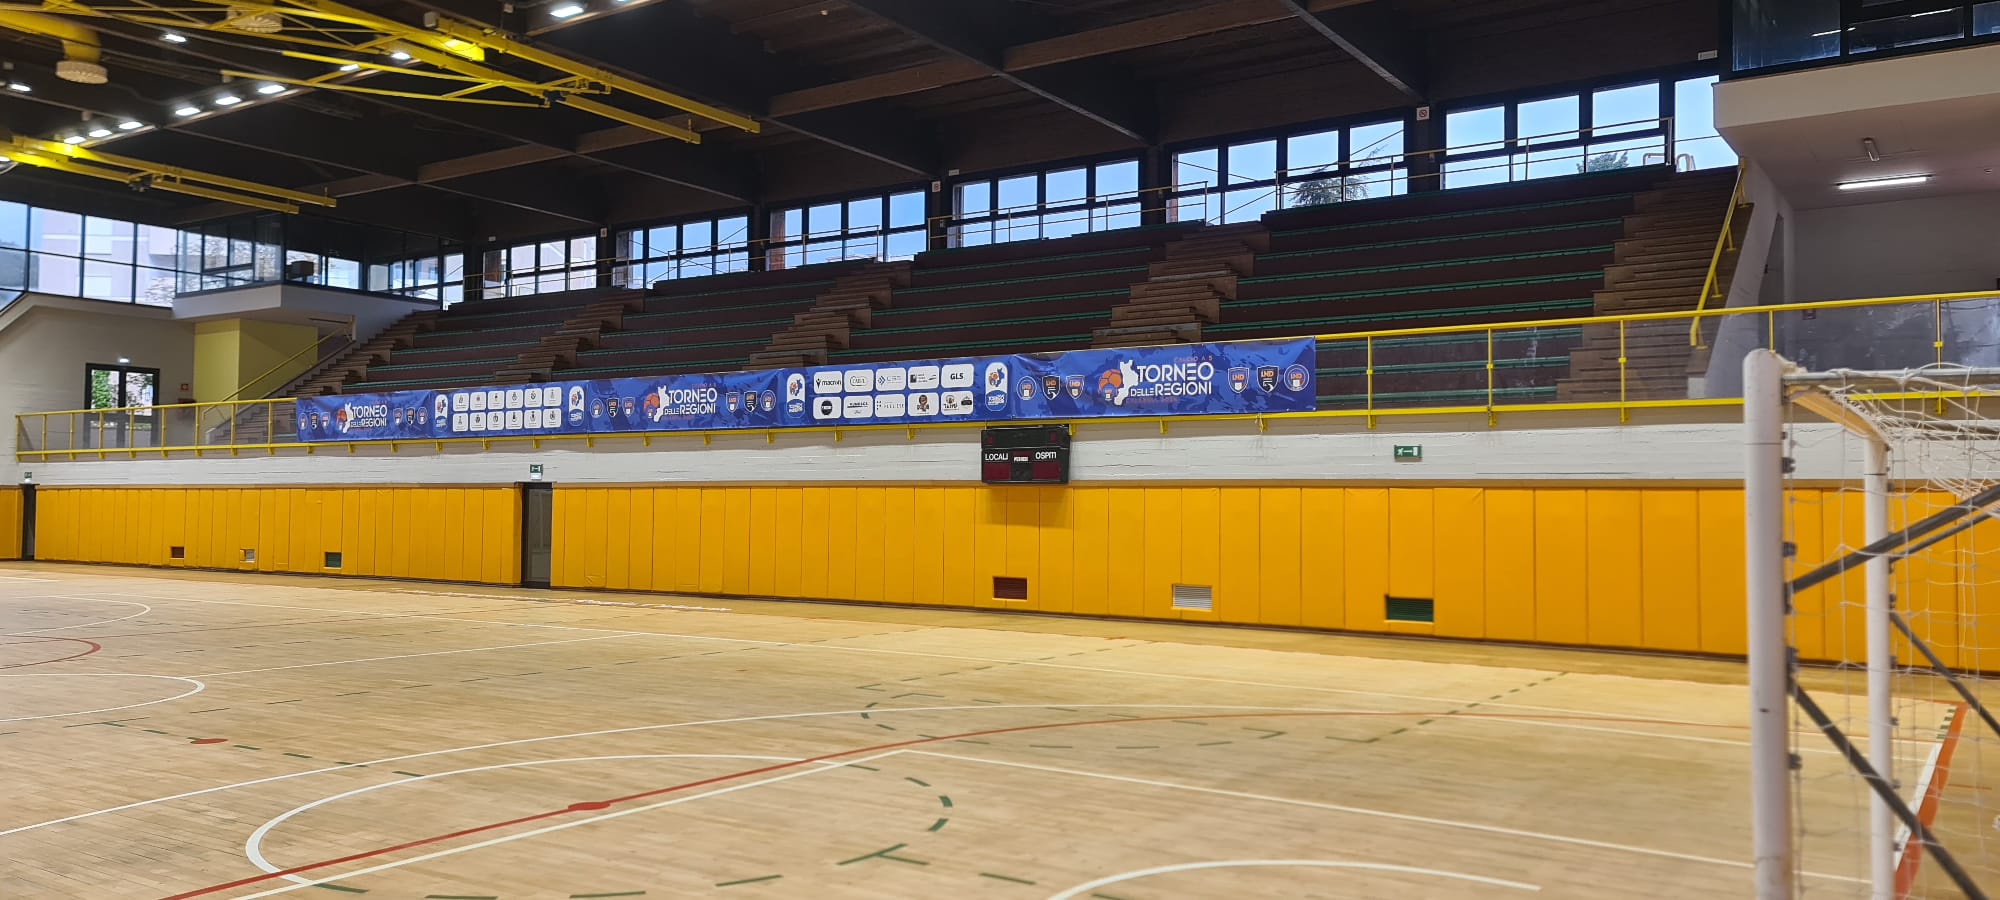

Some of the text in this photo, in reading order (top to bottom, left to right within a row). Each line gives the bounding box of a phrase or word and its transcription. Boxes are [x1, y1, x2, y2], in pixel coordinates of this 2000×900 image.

[950, 372, 964, 380] GLS
[1136, 361, 1215, 383] TORNEO
[668, 387, 718, 404] TORNEO
[1130, 381, 1213, 397] DELLE REGIONI
[352, 404, 388, 418] TORNEO
[664, 402, 716, 415] DELLE REGIONI
[361, 417, 388, 428] REGIONI
[985, 453, 1008, 461] LOCALI
[1035, 451, 1057, 460] OSPITI
